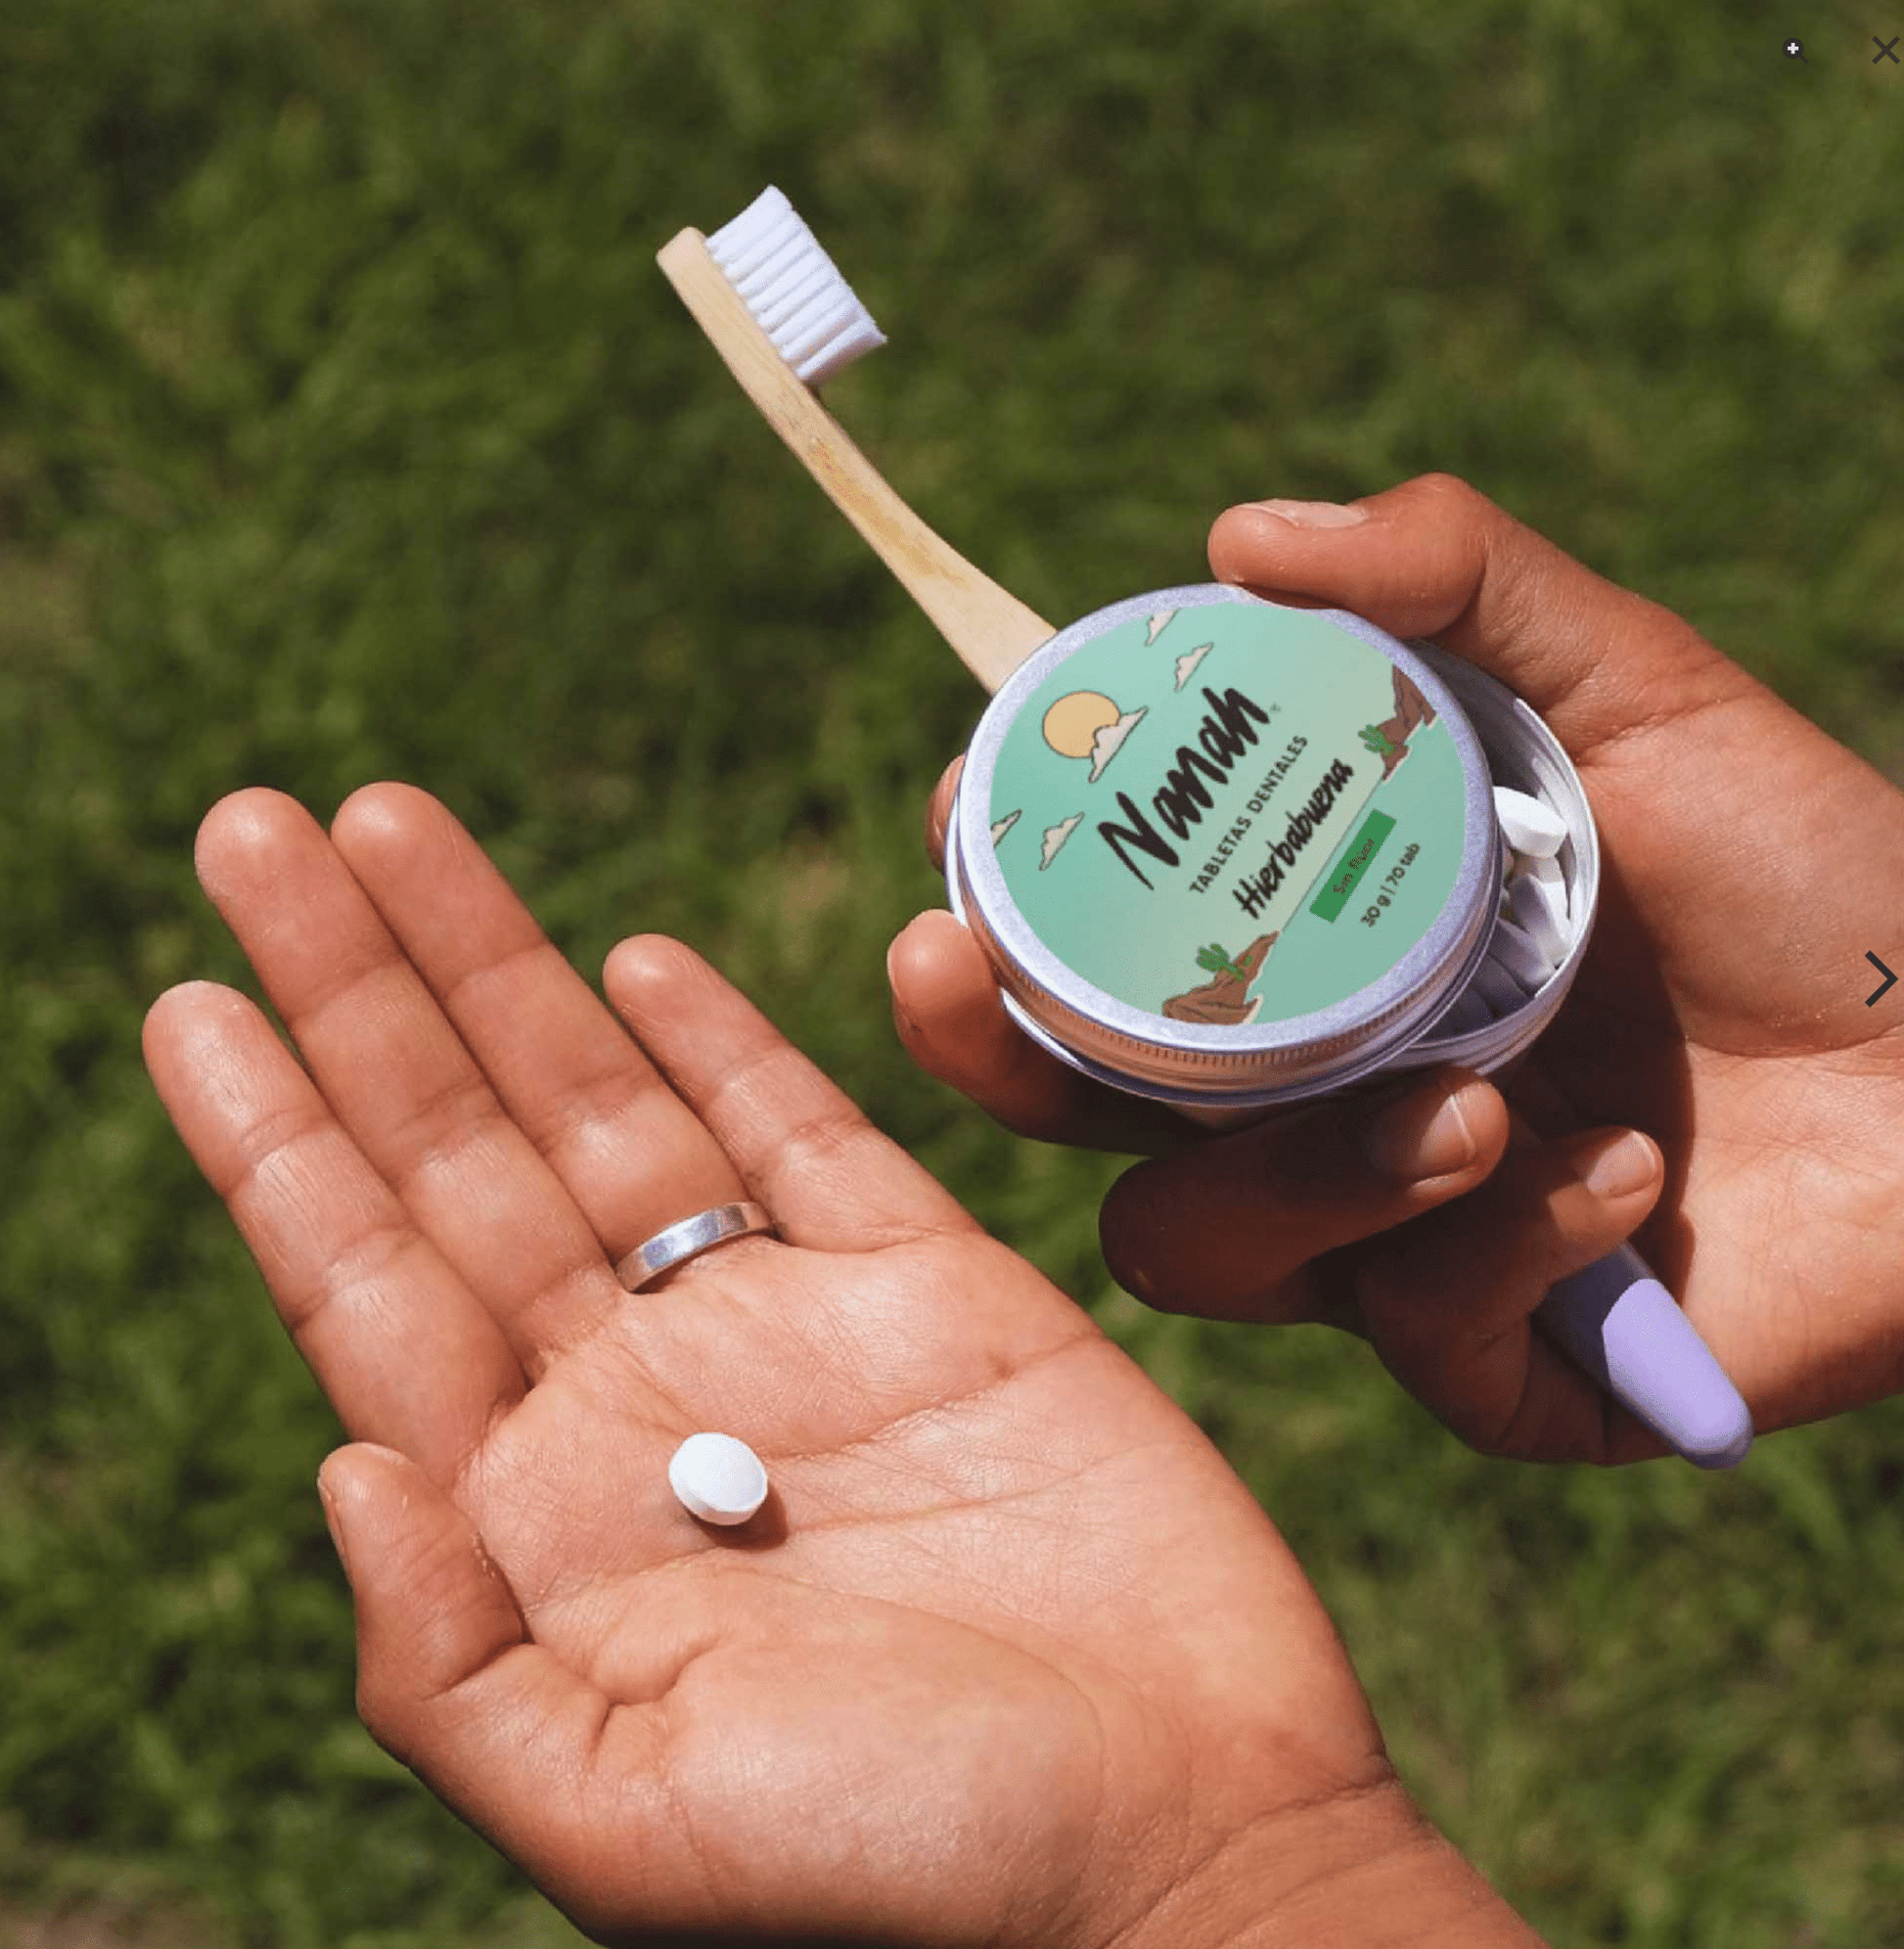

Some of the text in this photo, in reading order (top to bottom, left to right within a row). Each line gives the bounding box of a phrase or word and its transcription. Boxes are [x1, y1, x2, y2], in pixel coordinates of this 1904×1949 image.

[1097, 687, 1270, 890] Namah
[1189, 735, 1308, 894] TABLETAS DENTALES
[1232, 757, 1354, 920] Hierbabuena
[1360, 905, 1381, 928] 30
[1376, 894, 1391, 908] g
[1384, 866, 1406, 886] 70
[1399, 842, 1421, 866] tab
